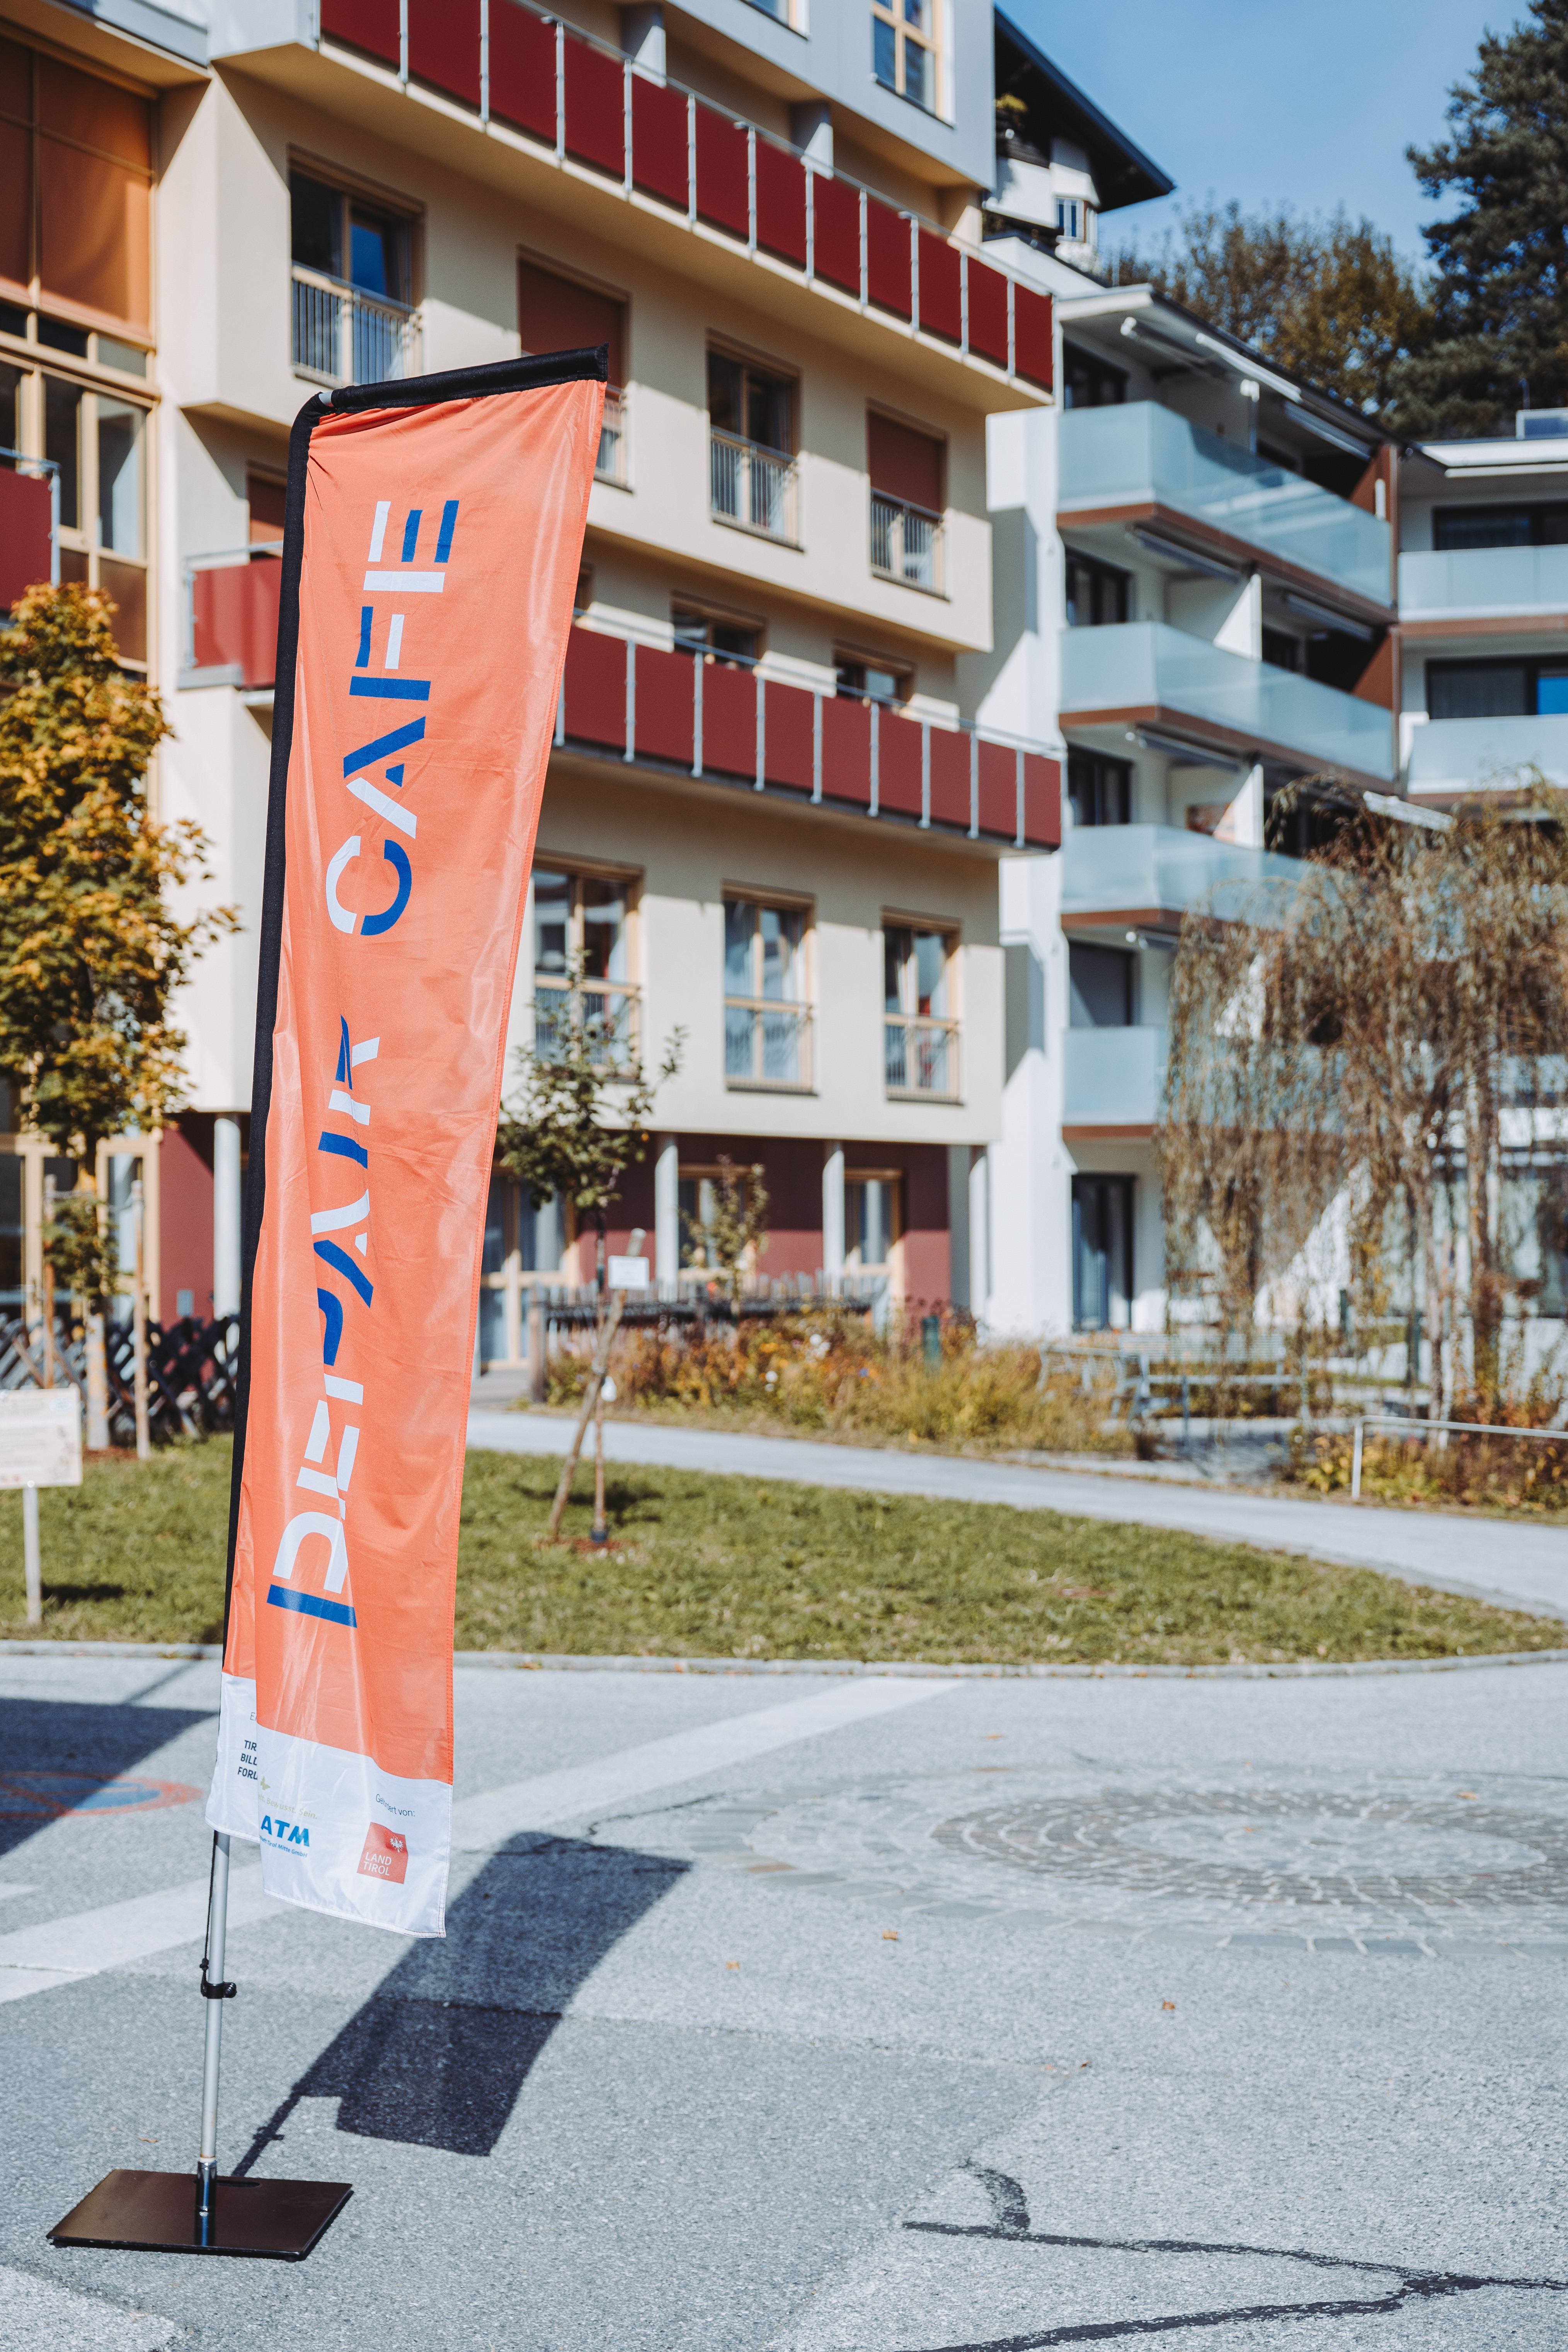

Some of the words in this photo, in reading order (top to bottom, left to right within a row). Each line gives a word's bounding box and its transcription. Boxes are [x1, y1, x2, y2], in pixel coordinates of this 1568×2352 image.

[326, 500, 459, 936] CAFE
[267, 1798, 296, 1814] Bewusst.
[299, 1808, 318, 1819] Sein.
[261, 1815, 310, 1847] ATM
[278, 1844, 291, 1853] Mitte
[291, 1849, 308, 1858] GmbH
[365, 1851, 392, 1866] LAND
[363, 1861, 390, 1876] TIROL
